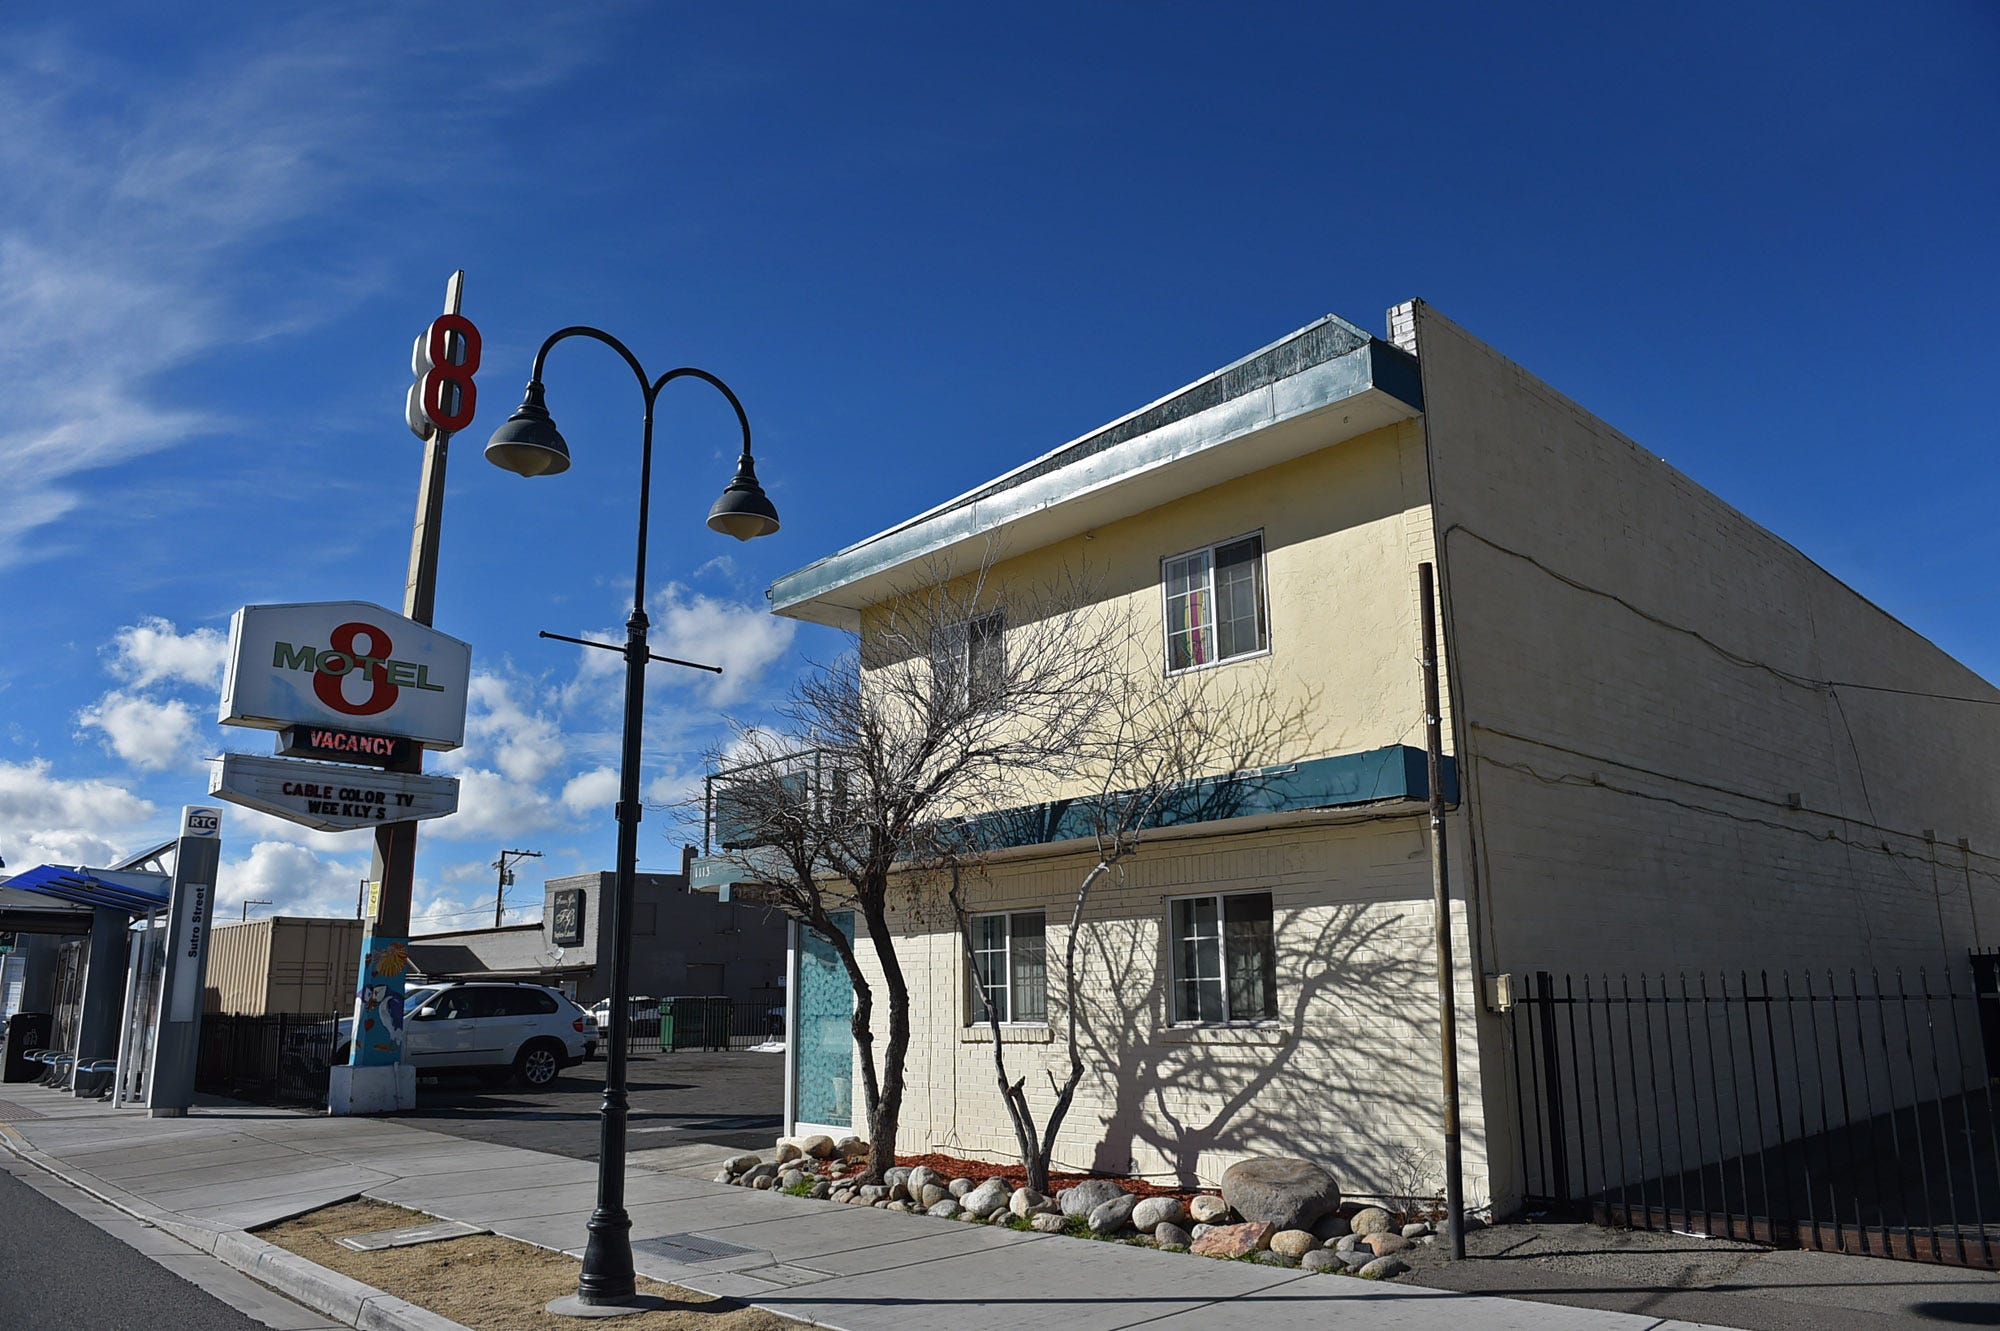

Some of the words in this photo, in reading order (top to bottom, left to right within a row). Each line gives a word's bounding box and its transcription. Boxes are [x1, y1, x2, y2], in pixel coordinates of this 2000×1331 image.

[424, 314, 482, 432] 8
[272, 641, 444, 692] MOTEL
[313, 622, 399, 715] 8
[311, 730, 396, 756] VACANCY
[282, 782, 333, 799] CABLE
[338, 788, 386, 805] COLOR
[395, 793, 415, 807] TV
[190, 816, 216, 828] RTC
[192, 887, 205, 923] Street
[188, 926, 200, 958] Sutro
